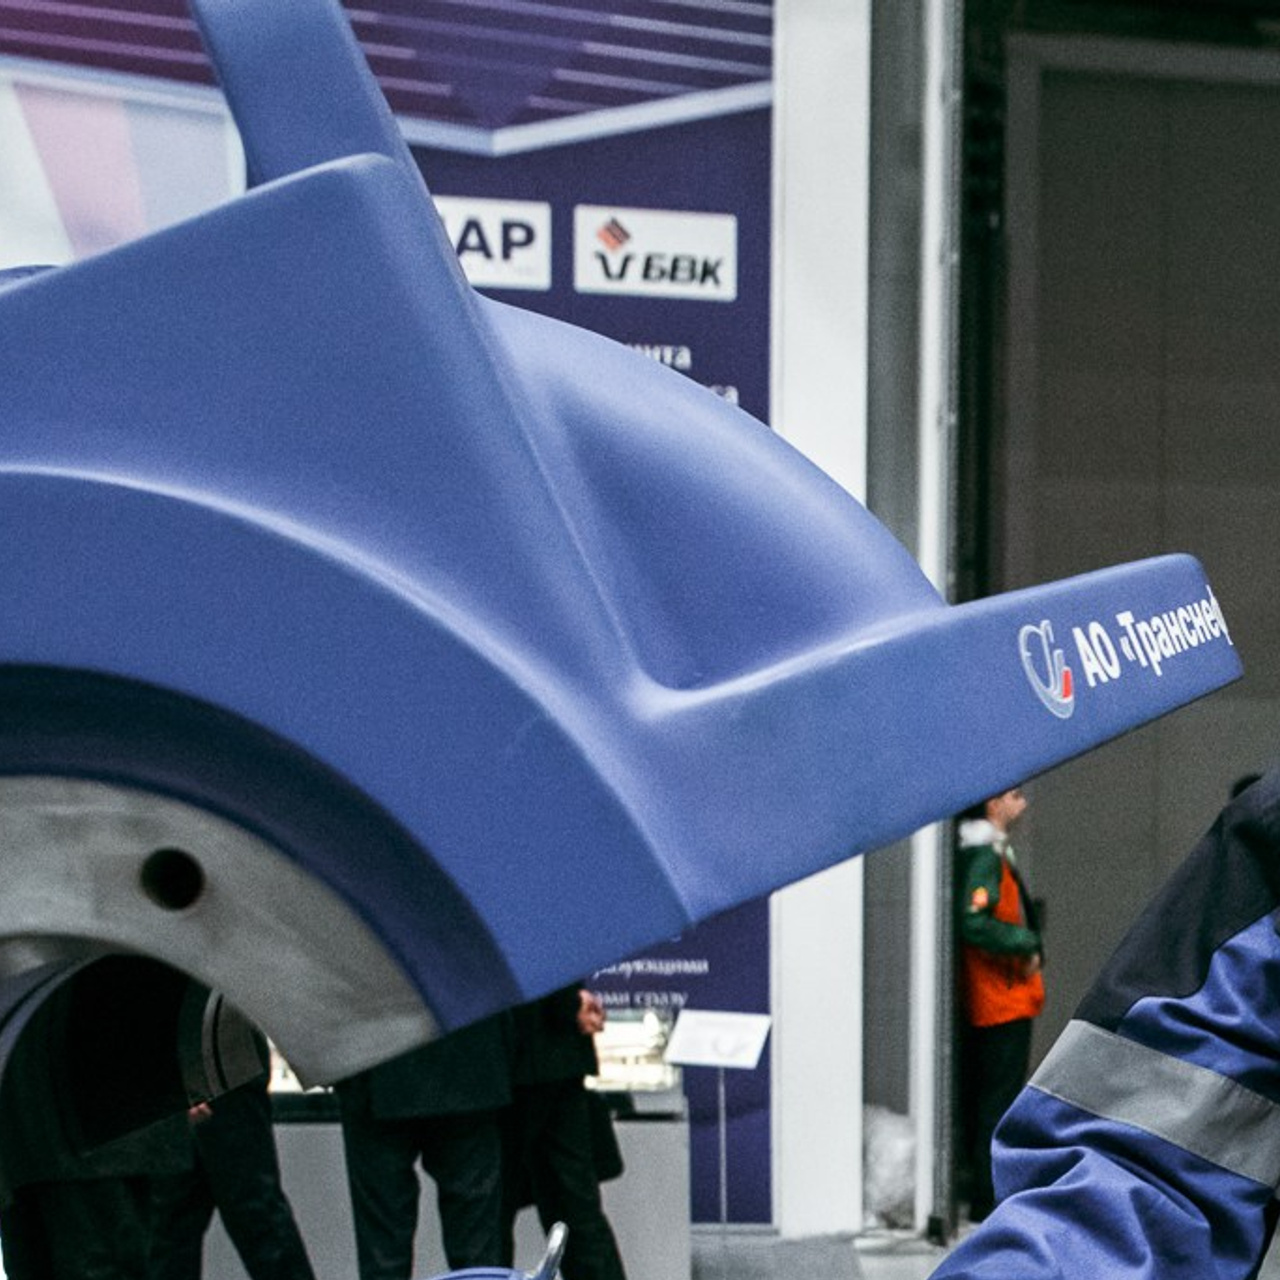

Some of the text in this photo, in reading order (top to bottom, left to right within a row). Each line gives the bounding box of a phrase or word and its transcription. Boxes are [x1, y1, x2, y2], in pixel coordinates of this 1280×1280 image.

[444, 218, 535, 260] АР
[642, 253, 724, 288] БВК
[1073, 621, 1122, 688] АО
